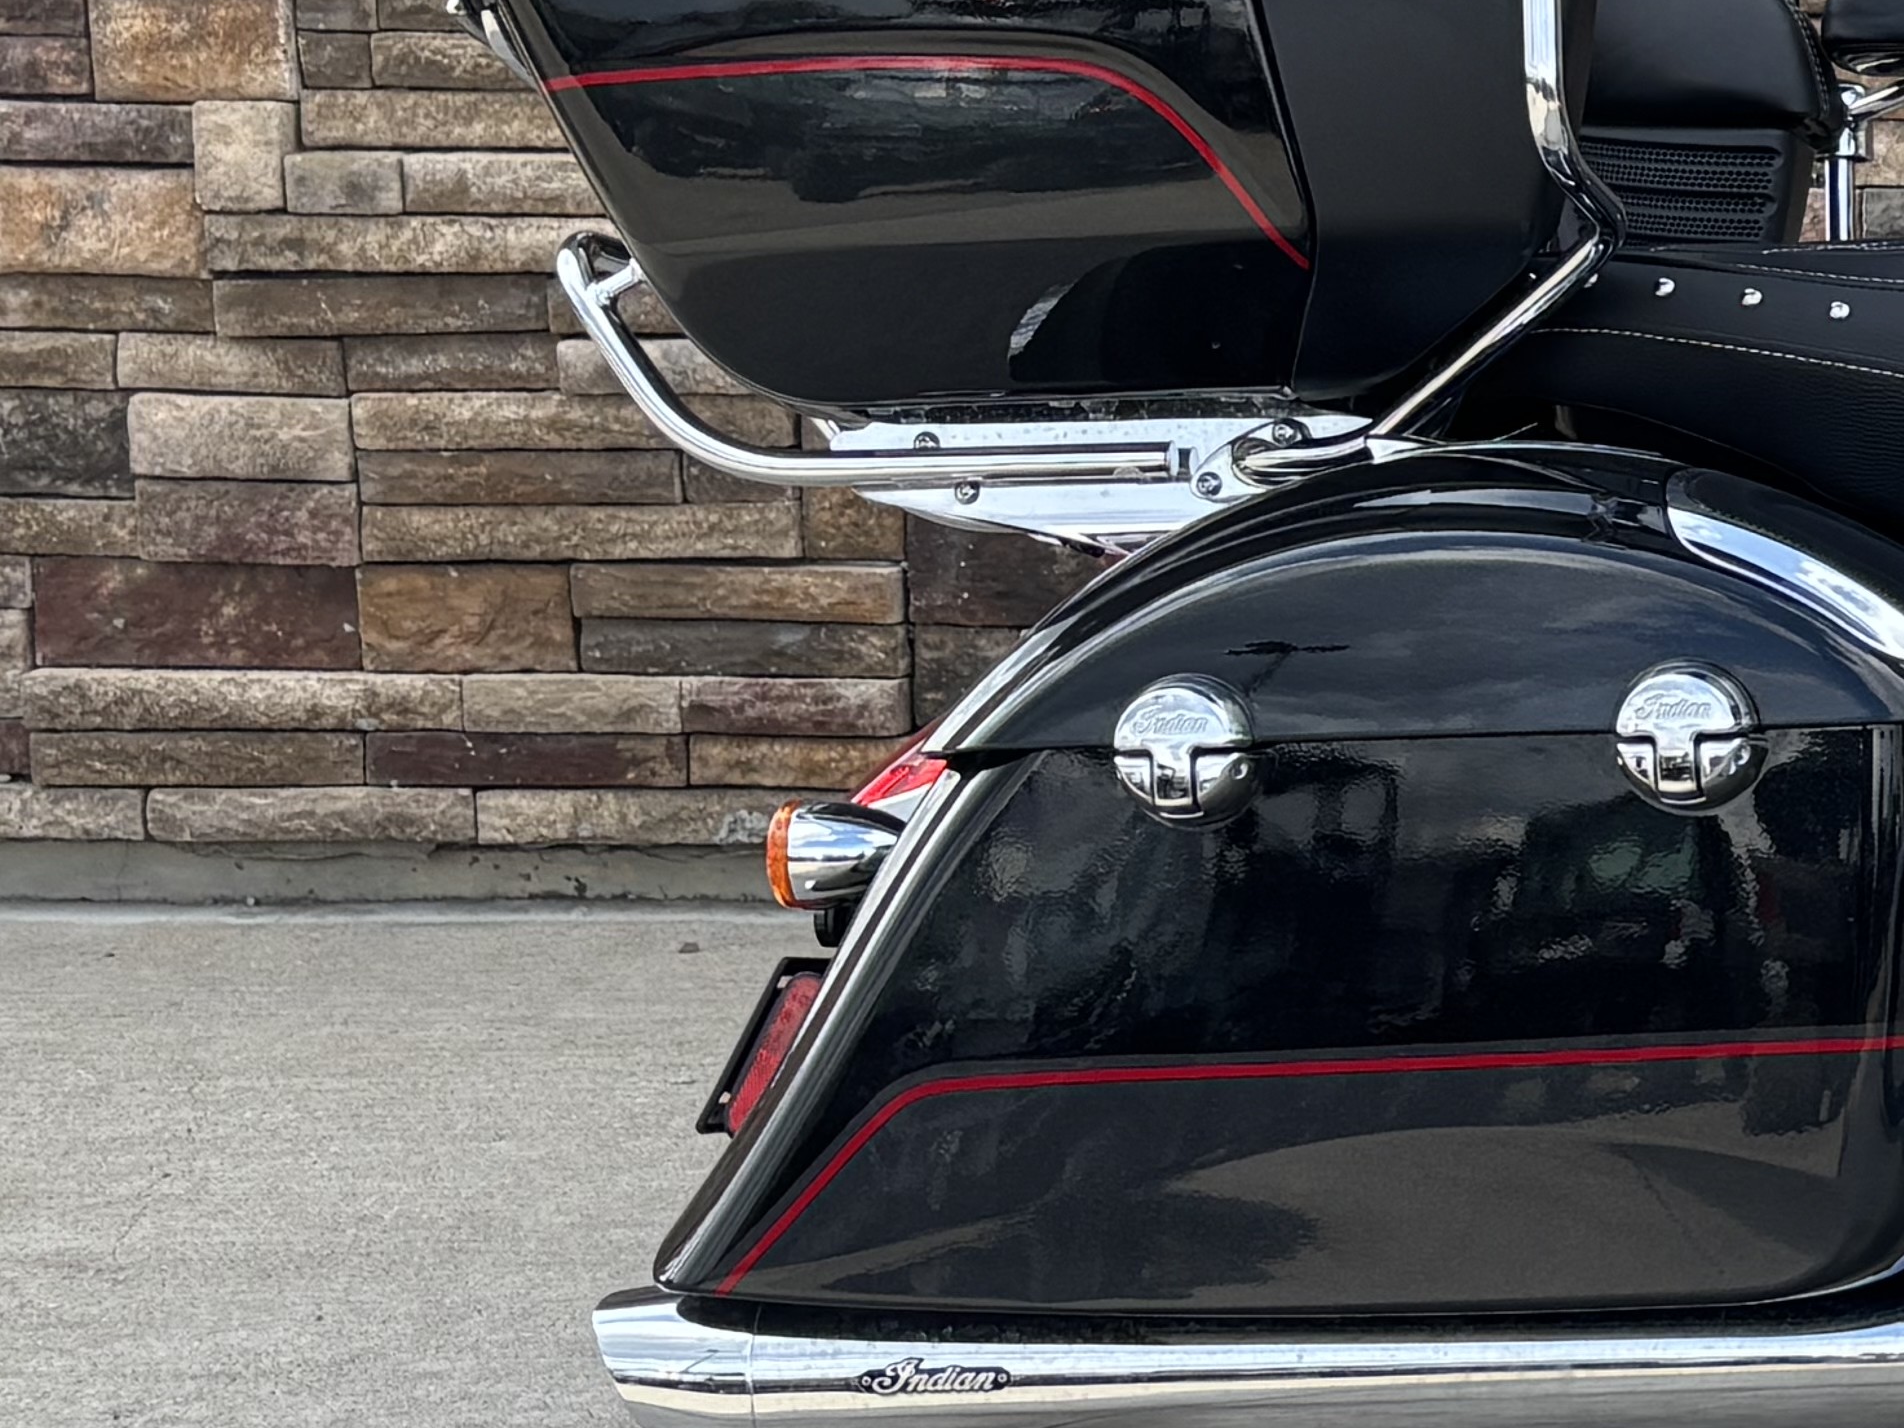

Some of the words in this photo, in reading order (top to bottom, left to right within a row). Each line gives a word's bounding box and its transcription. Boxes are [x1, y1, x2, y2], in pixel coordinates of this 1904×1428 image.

[1132, 705, 1210, 735] Indian
[1634, 692, 1713, 721] Indian
[872, 1358, 996, 1395] Indian
